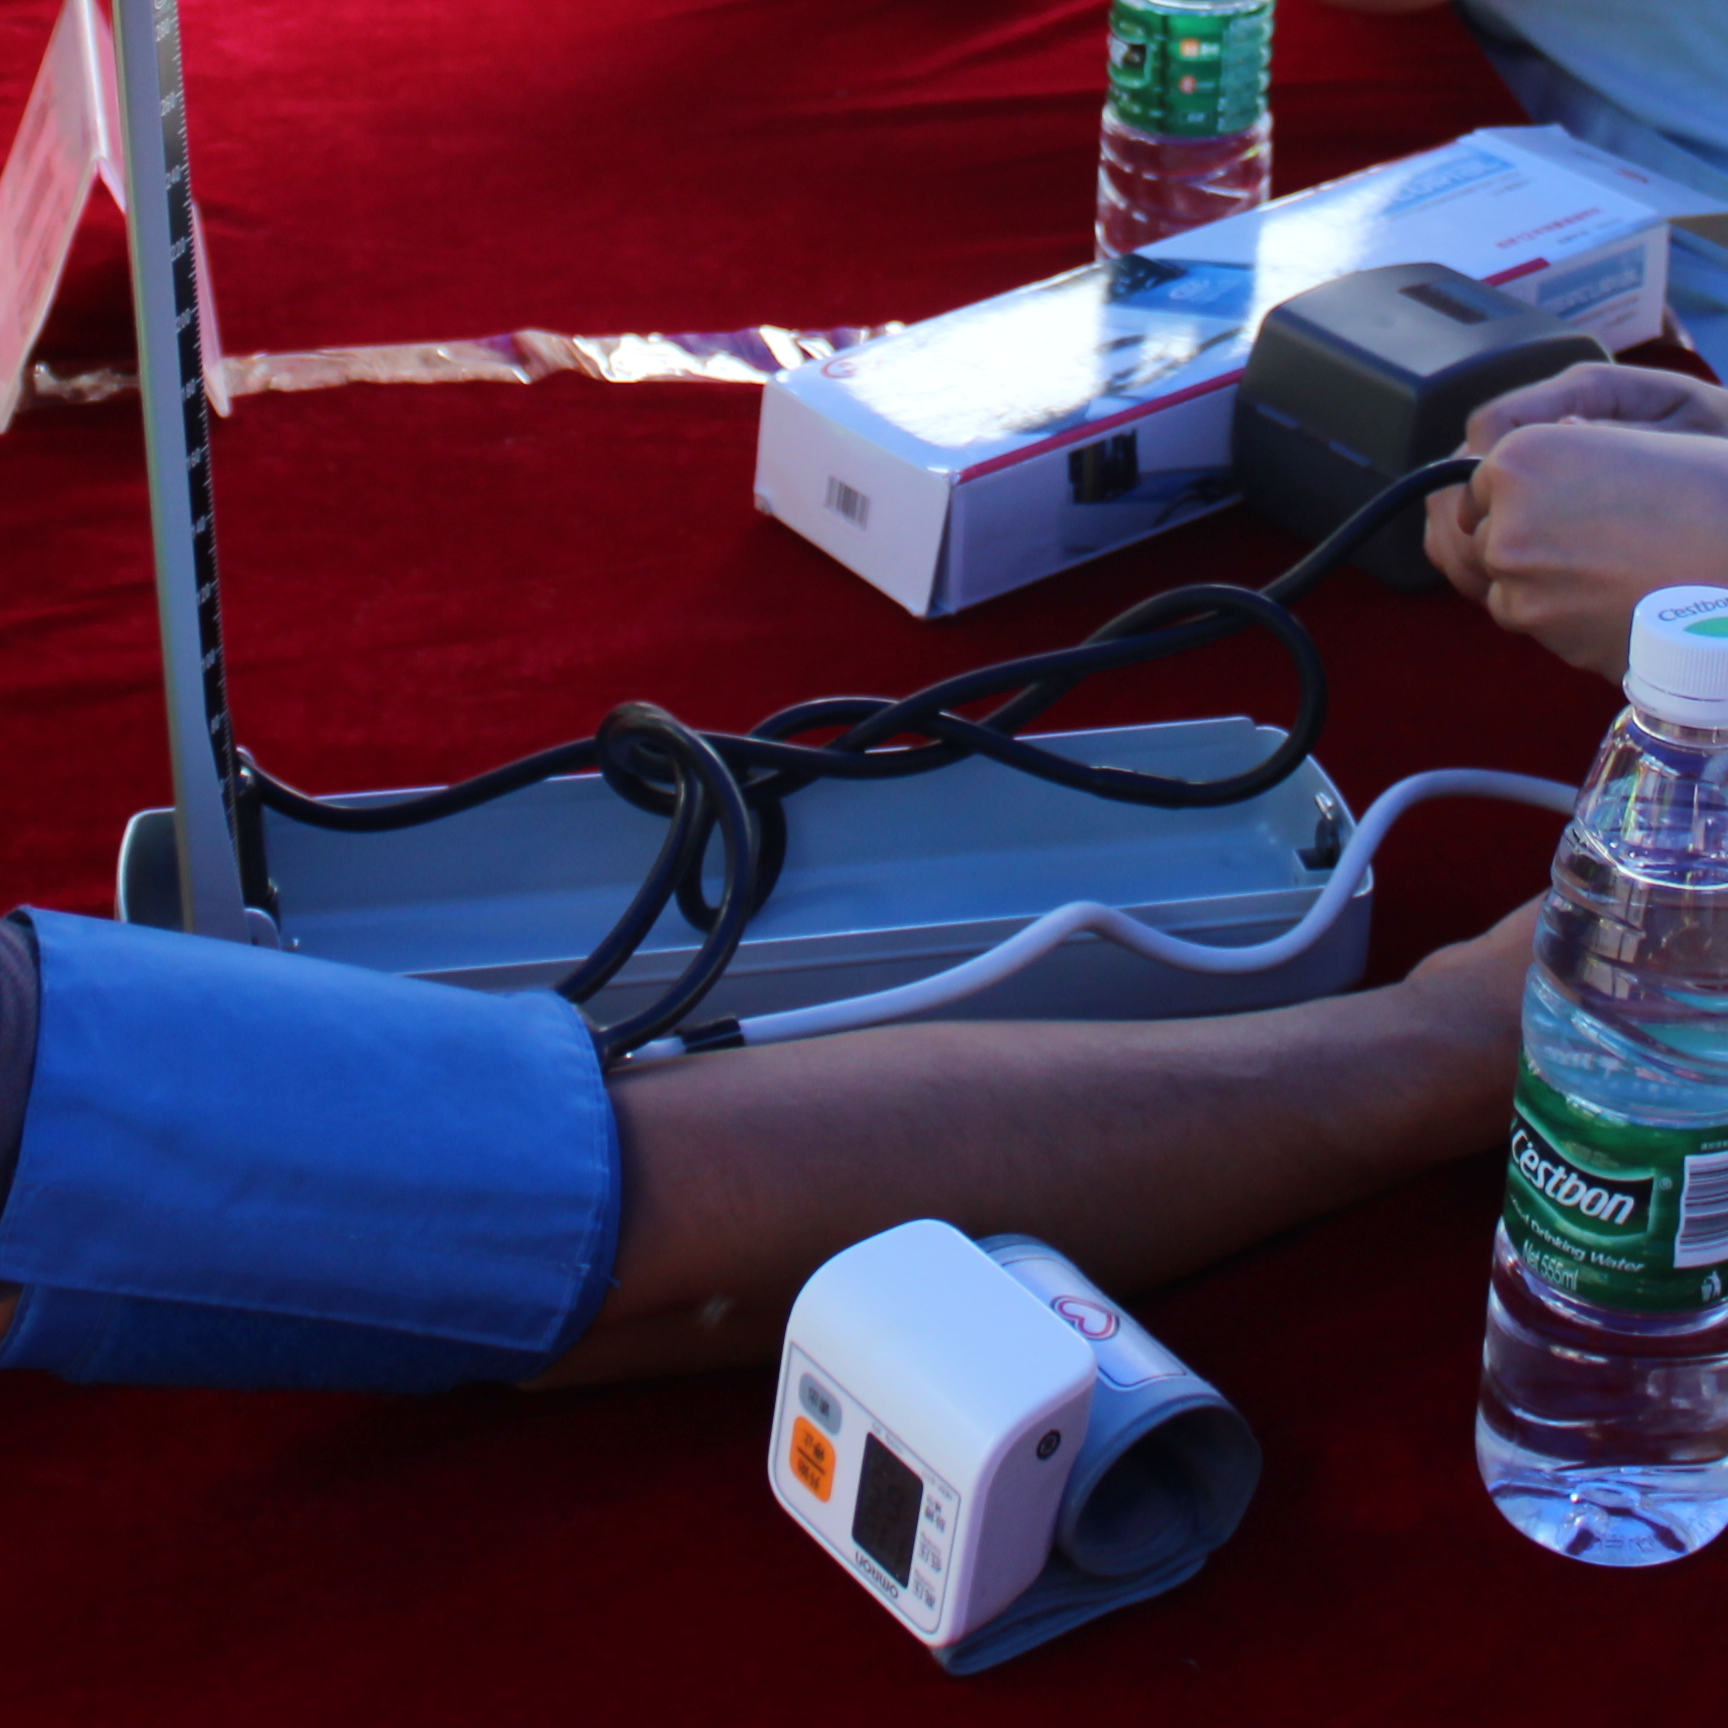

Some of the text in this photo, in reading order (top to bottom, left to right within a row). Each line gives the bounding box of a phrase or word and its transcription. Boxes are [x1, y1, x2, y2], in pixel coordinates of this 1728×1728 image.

[1522, 1239, 1541, 1271] Net
[1530, 1219, 1646, 1273] Drinking Water
